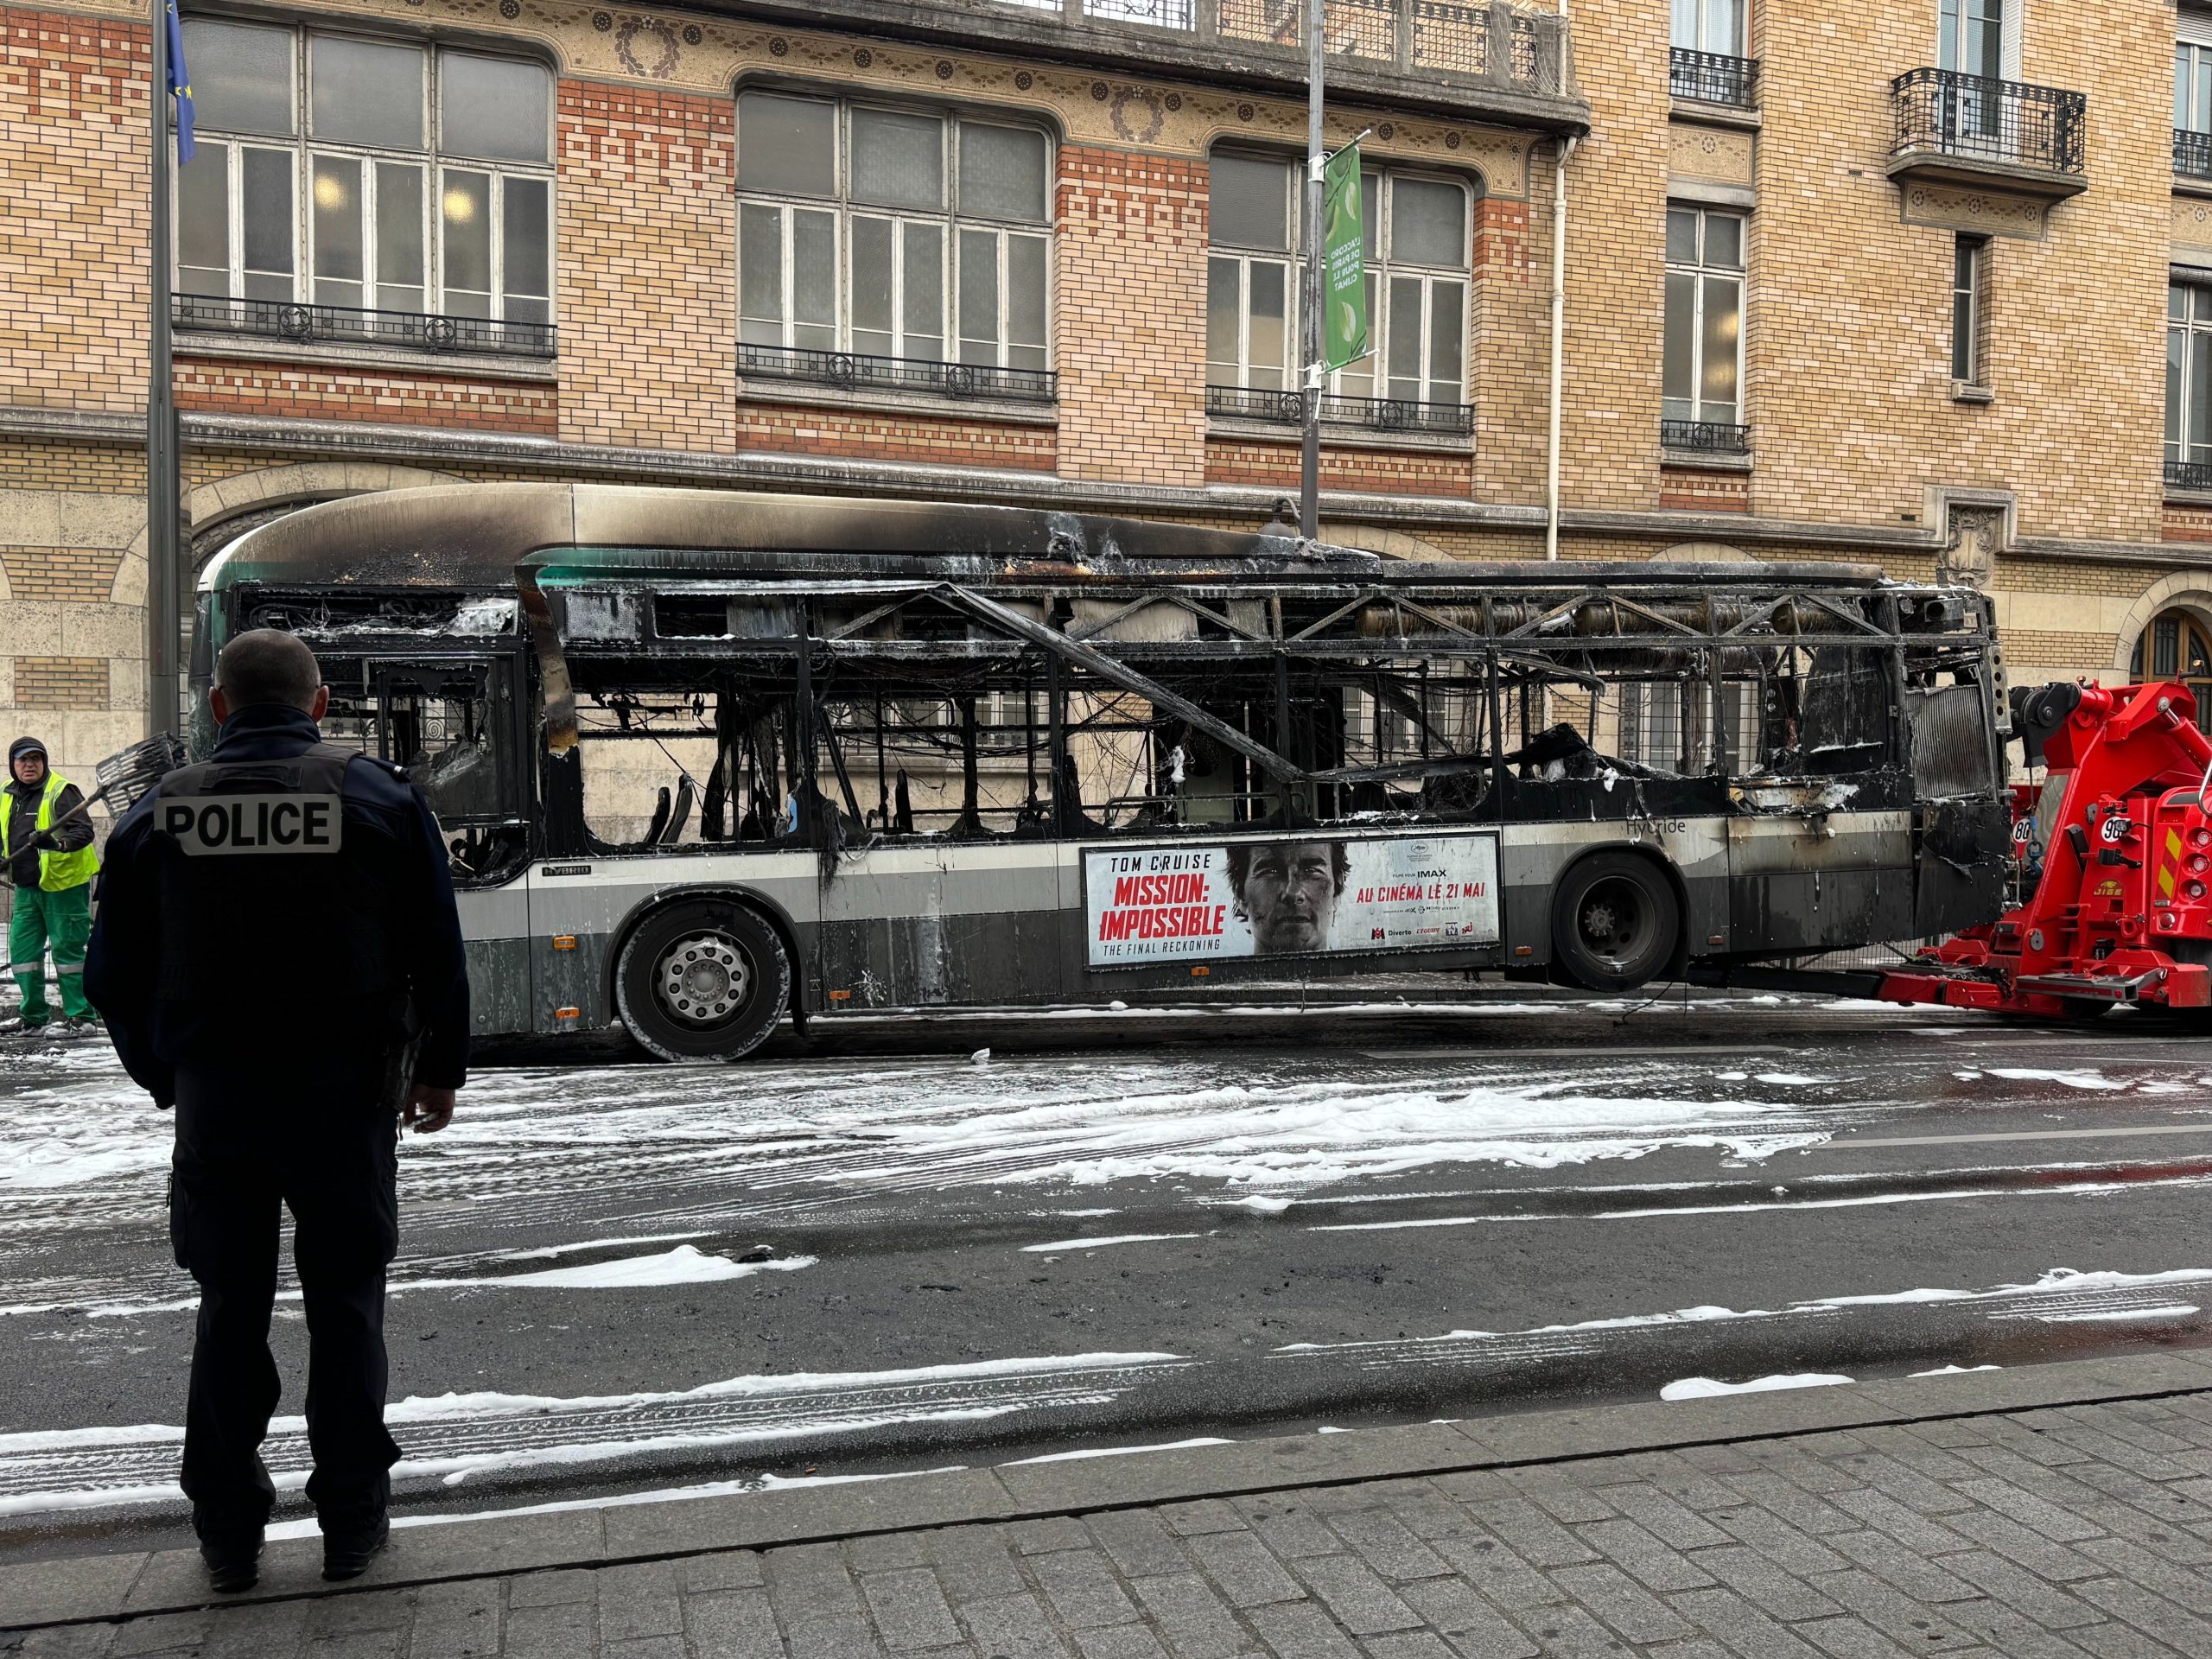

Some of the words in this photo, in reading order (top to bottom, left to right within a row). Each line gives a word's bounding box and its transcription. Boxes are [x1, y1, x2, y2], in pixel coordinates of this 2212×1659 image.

[165, 802, 330, 848] POLICE
[2015, 822, 2031, 840] 80
[1111, 856, 1142, 873] TOM
[1150, 854, 1211, 872] CRUISE
[1417, 869, 1446, 879] IMAX
[1114, 873, 1210, 907] MISSION:
[1357, 887, 1374, 904] AU
[1377, 883, 1423, 902] CINÉMA
[1427, 884, 1442, 899] LE
[1446, 883, 1459, 899] 21
[1463, 882, 1485, 898] MAI
[1099, 905, 1226, 942] IMPOSSIBLE
[1104, 944, 1122, 957] THE
[1127, 943, 1156, 955] FINAL
[1162, 939, 1220, 953] RECKONING
